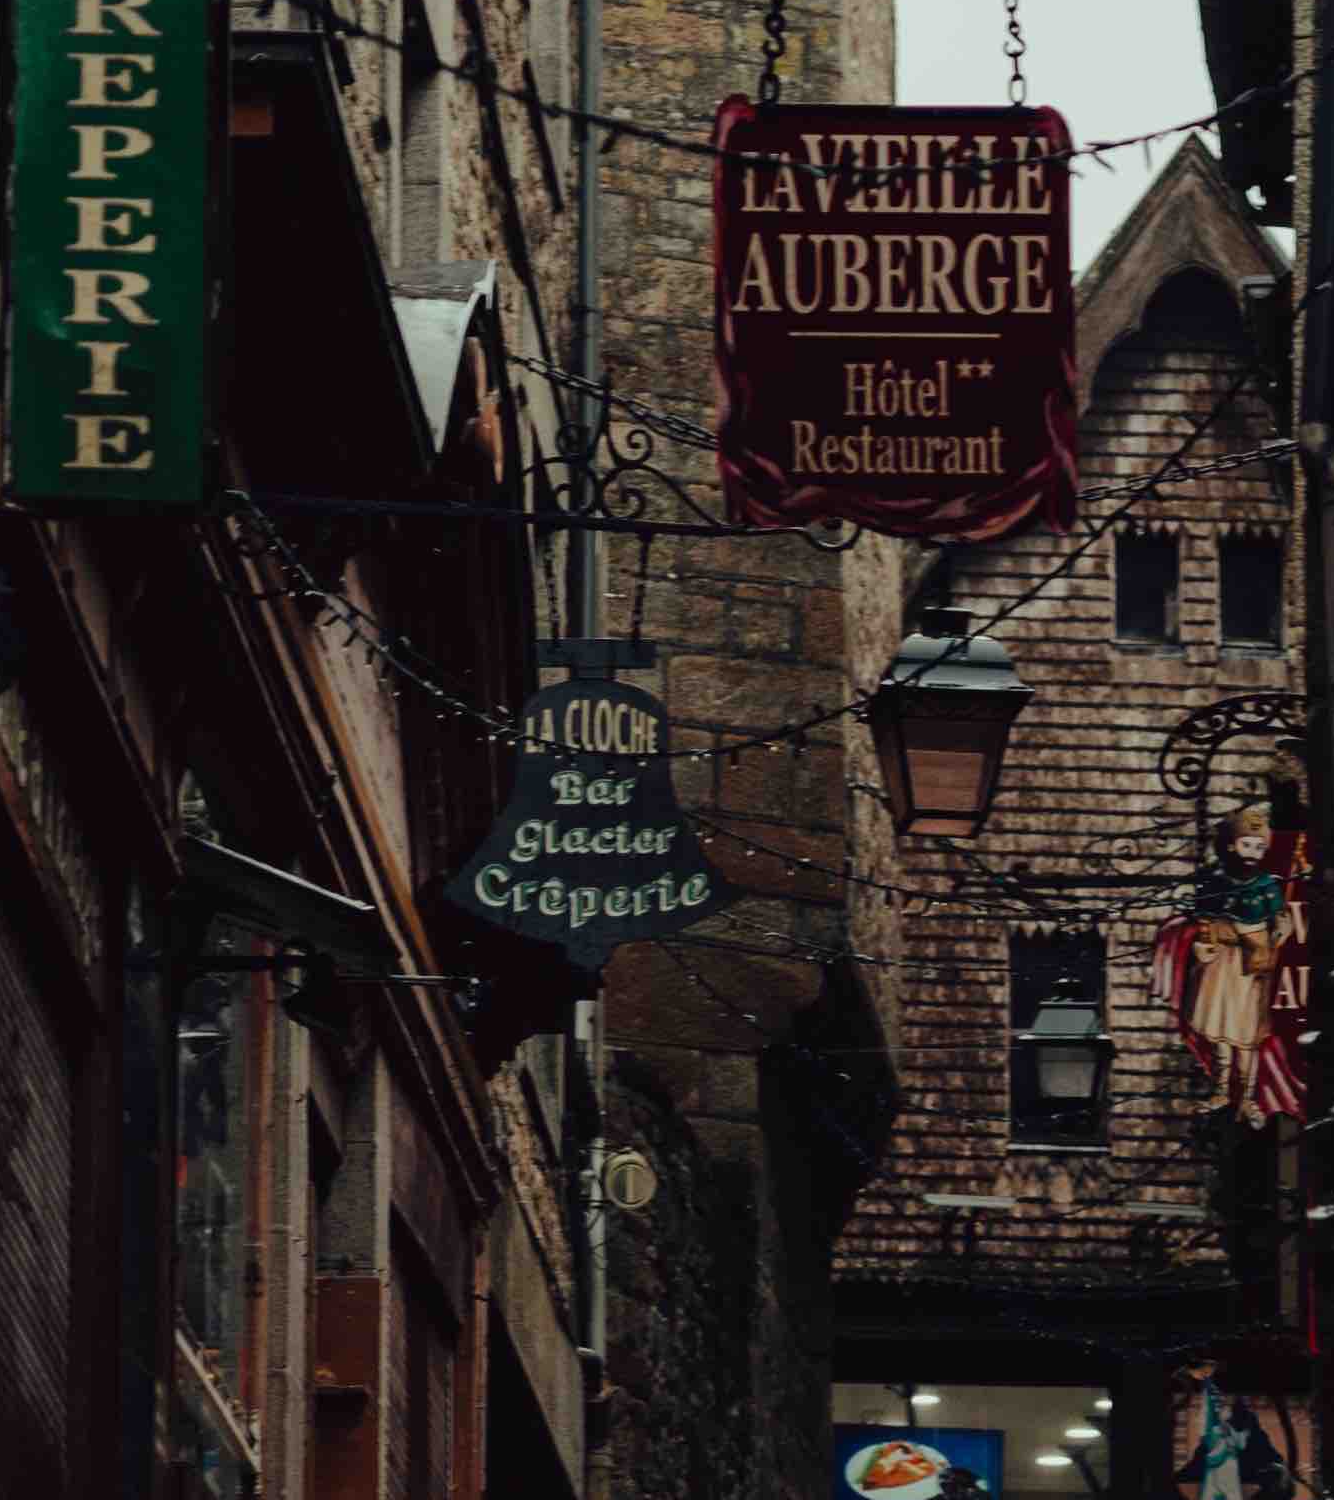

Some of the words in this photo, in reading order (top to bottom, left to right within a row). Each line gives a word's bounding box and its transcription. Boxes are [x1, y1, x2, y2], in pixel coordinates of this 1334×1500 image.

[739, 150, 804, 213] LA
[799, 133, 1053, 215] VIEILLE
[731, 232, 1053, 315] AUBERGE
[789, 419, 1007, 475] Restaurant
[523, 707, 556, 754] LA
[564, 698, 660, 754] CLOCHE
[549, 770, 637, 805] Bar
[508, 818, 679, 863] Glacier
[473, 862, 712, 929] Crêperie
